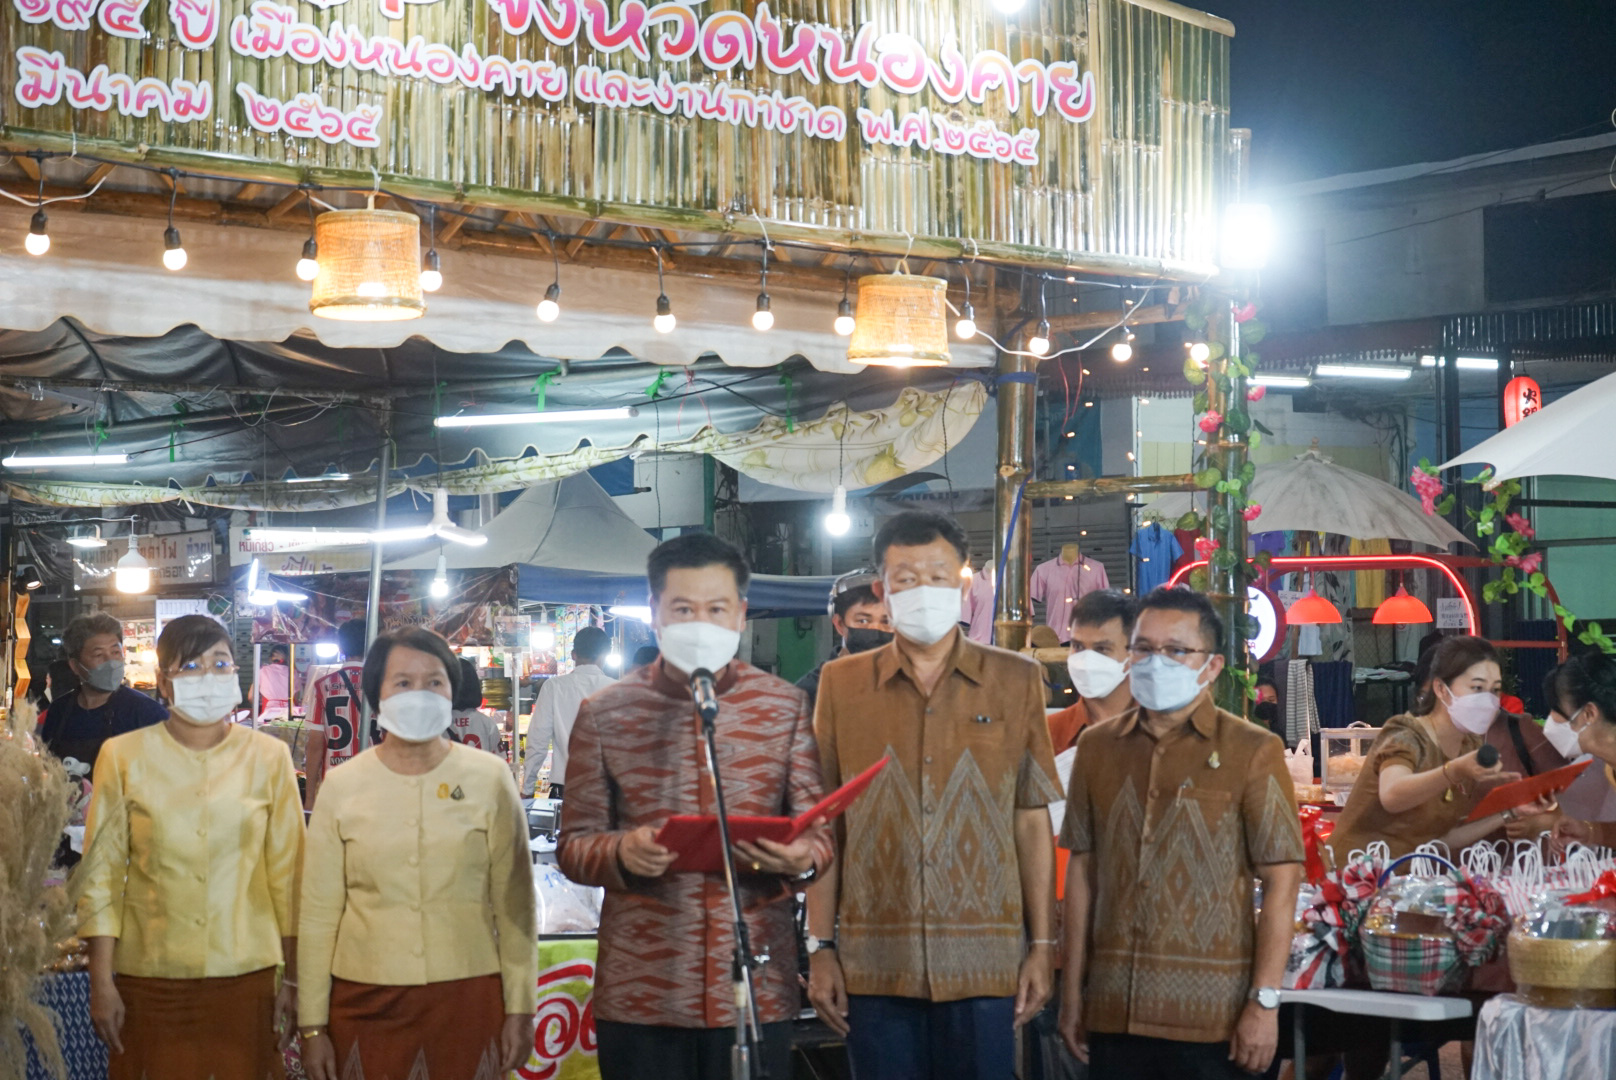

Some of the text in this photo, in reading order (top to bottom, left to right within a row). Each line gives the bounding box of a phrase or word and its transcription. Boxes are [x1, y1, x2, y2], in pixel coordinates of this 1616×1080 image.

[20, 51, 379, 143] มีนาคม ๒๕๖๕
[578, 68, 844, 137] และงานกาชาด
